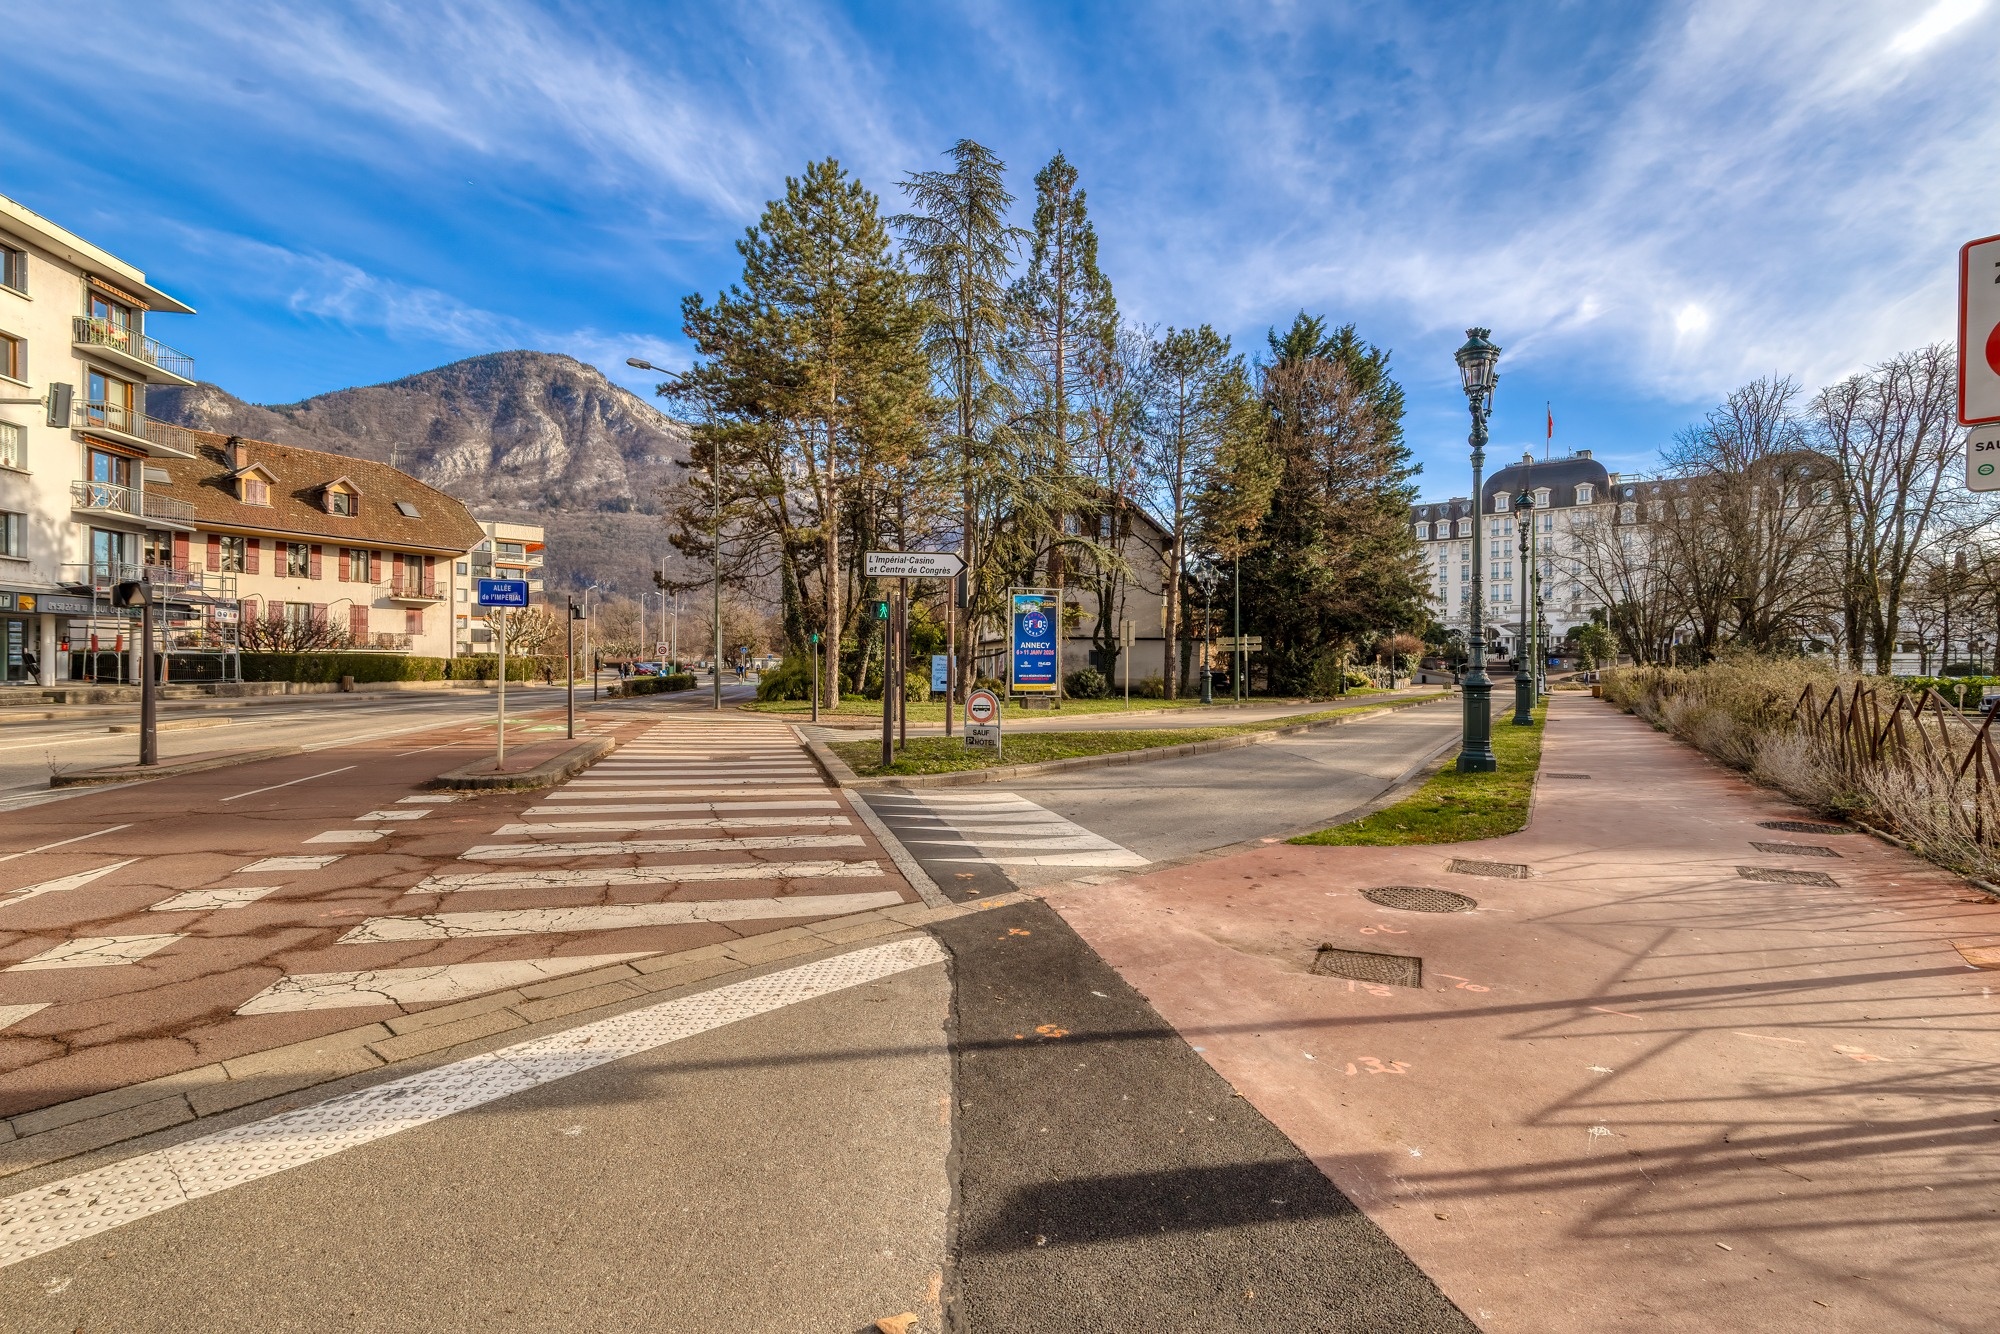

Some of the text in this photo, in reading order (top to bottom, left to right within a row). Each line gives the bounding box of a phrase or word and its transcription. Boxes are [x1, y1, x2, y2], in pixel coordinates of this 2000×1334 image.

[869, 555, 935, 565] L'Impérial-Casino
[880, 565, 905, 574] Centre
[908, 566, 918, 574] de
[920, 567, 951, 576] Congrès
[493, 584, 512, 592] ALLÉE
[974, 738, 996, 746] HÔTEL
